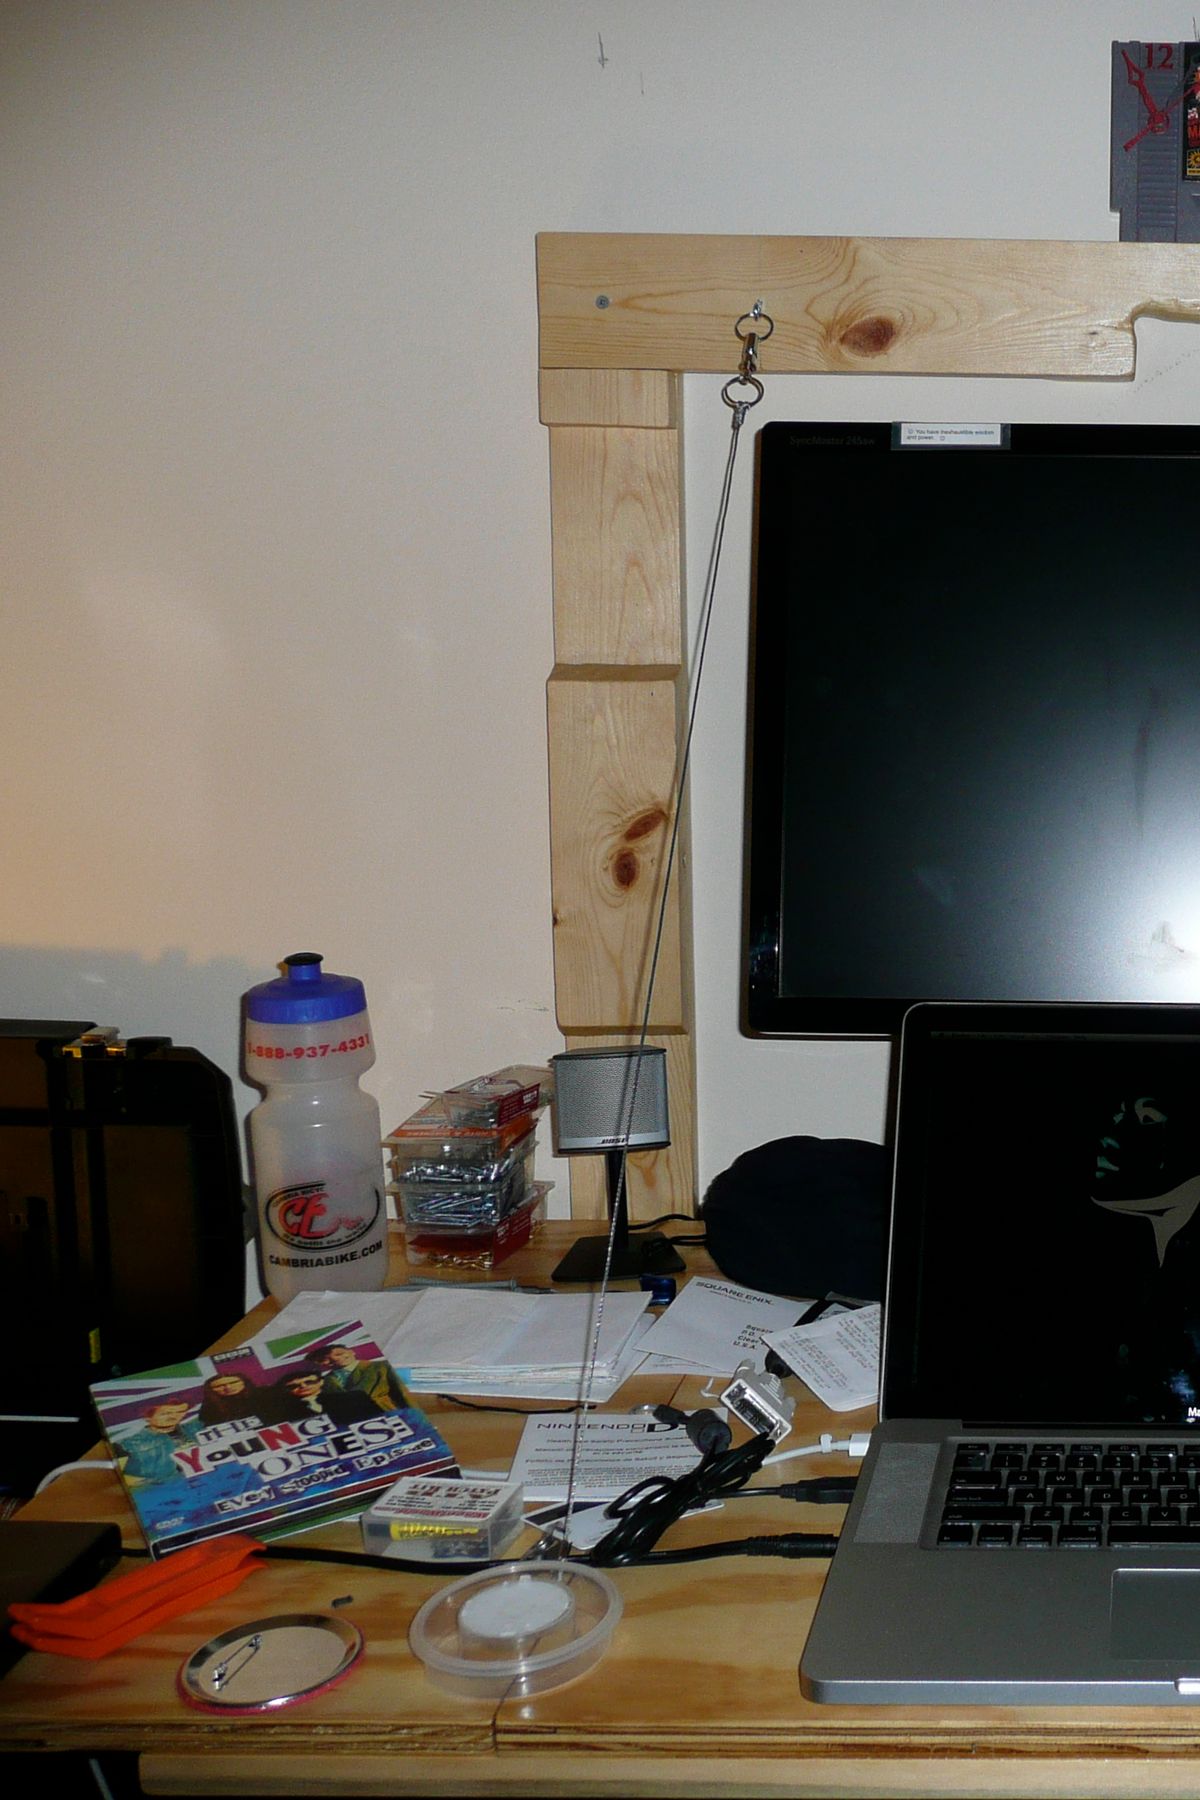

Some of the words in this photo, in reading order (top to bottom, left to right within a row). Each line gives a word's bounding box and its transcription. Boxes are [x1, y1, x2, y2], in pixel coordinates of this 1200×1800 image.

[1144, 44, 1174, 70] 12
[269, 1239, 383, 1268] CAMBRIABIKE.COM
[200, 1416, 261, 1443] THE
